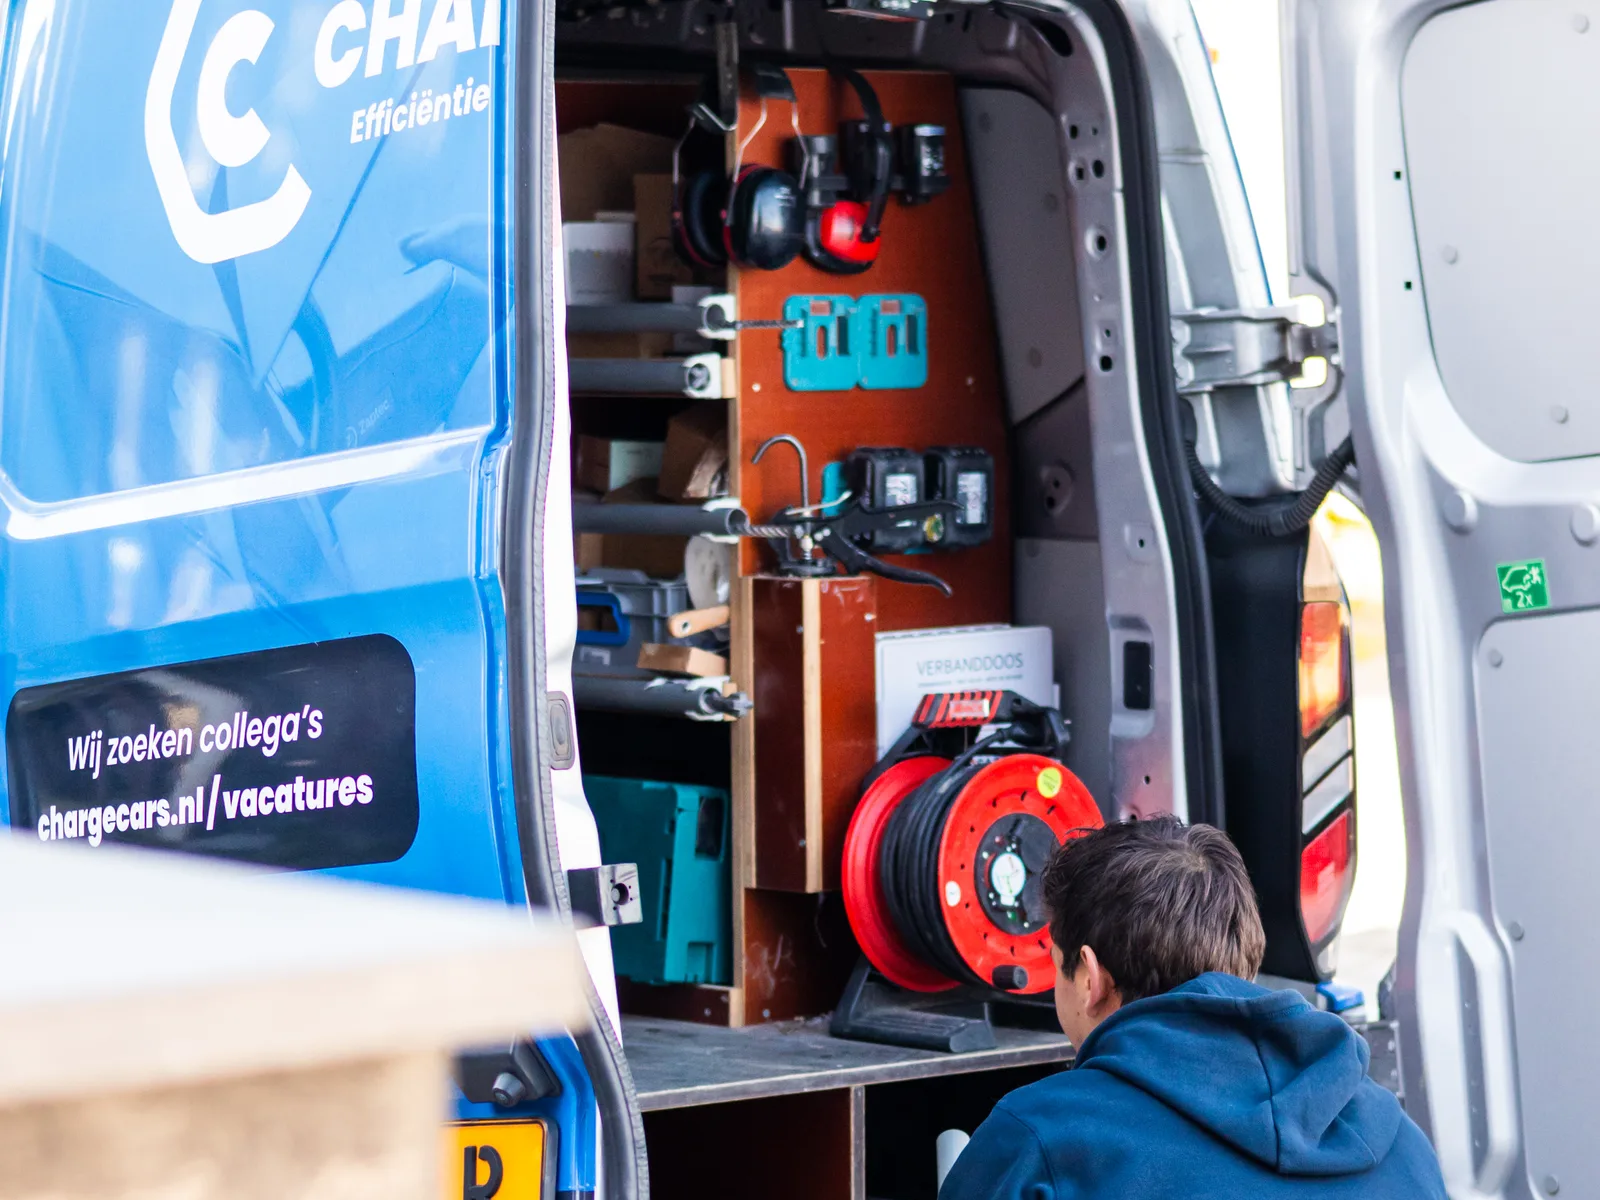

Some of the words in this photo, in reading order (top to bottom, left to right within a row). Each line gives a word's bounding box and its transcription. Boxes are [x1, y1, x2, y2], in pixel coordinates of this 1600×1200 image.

[350, 77, 491, 144] Efficiëntie
[916, 653, 1024, 676] VERBANDDOOS
[67, 730, 102, 779] Wij
[106, 724, 193, 767] zoeken
[199, 704, 323, 757] collega's
